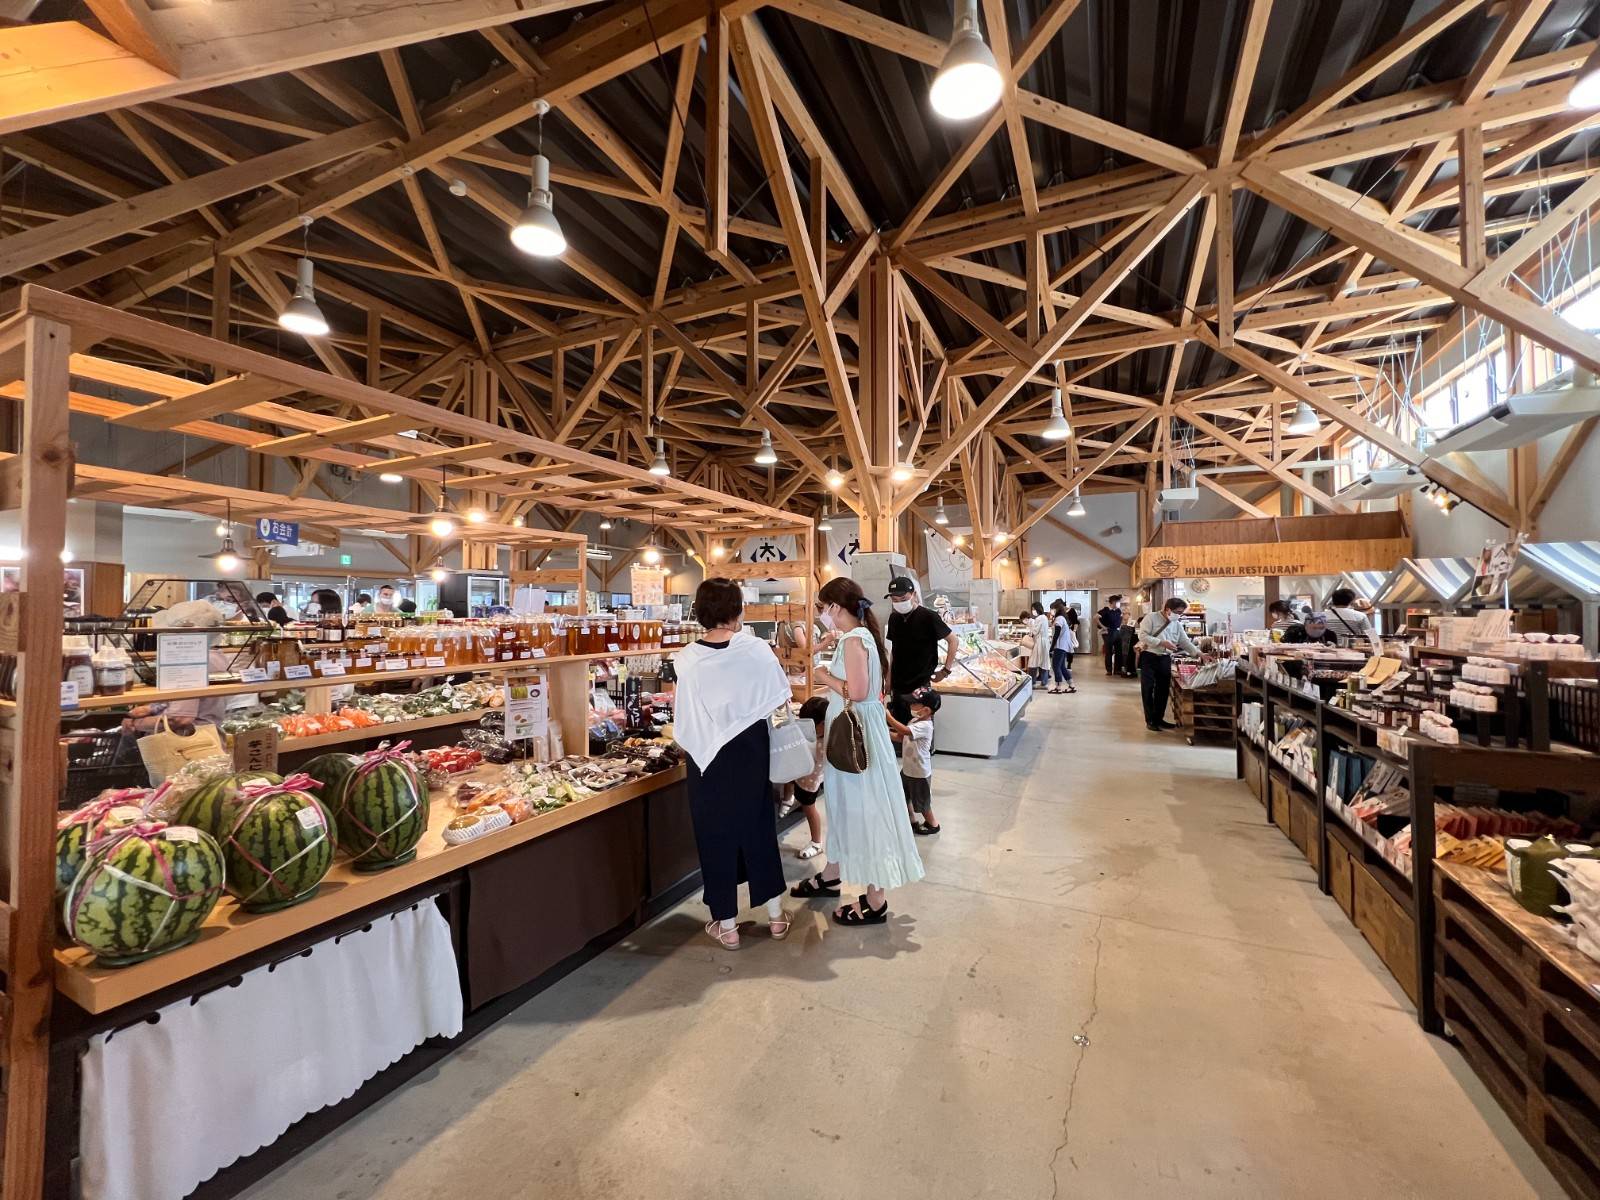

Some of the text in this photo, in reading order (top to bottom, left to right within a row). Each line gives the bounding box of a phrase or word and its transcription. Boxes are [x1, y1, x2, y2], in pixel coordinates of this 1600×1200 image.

[272, 520, 293, 537] お会計
[1185, 565, 1305, 575] HIDAMARI RESTAURANT
